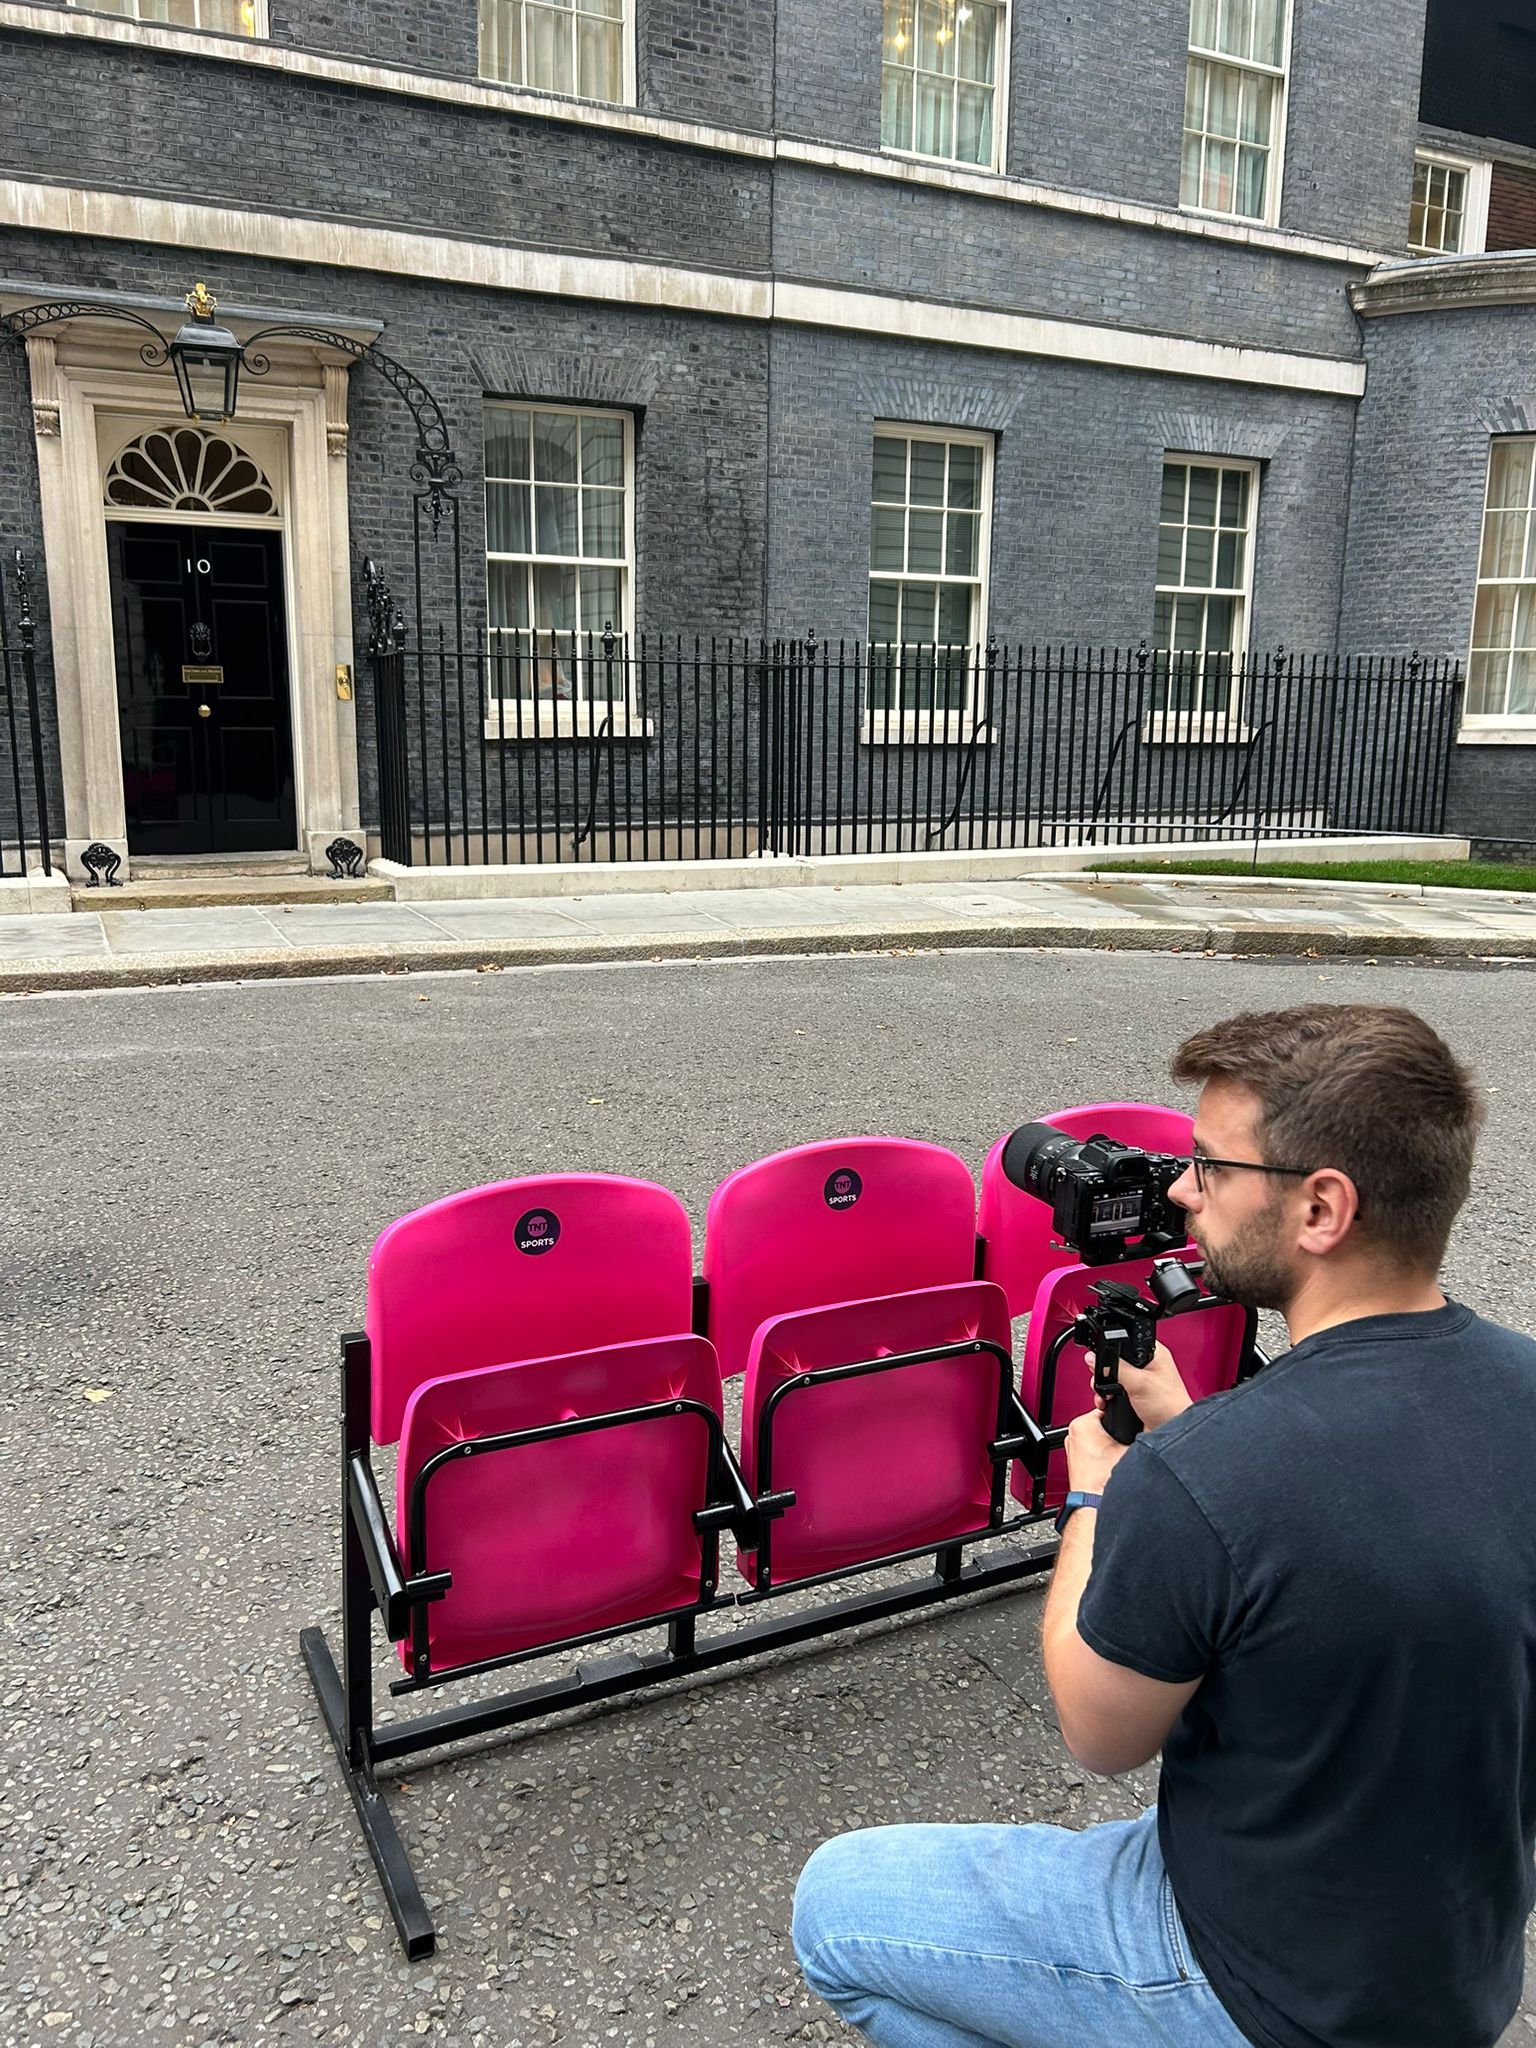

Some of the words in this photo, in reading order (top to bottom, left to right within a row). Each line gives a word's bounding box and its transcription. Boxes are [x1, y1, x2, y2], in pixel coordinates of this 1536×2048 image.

[187, 559, 211, 574] 10
[835, 1181, 852, 1191] TNT
[829, 1194, 857, 1205] SPORTS
[528, 1222, 548, 1233] TNT
[521, 1237, 554, 1249] SPORTS
